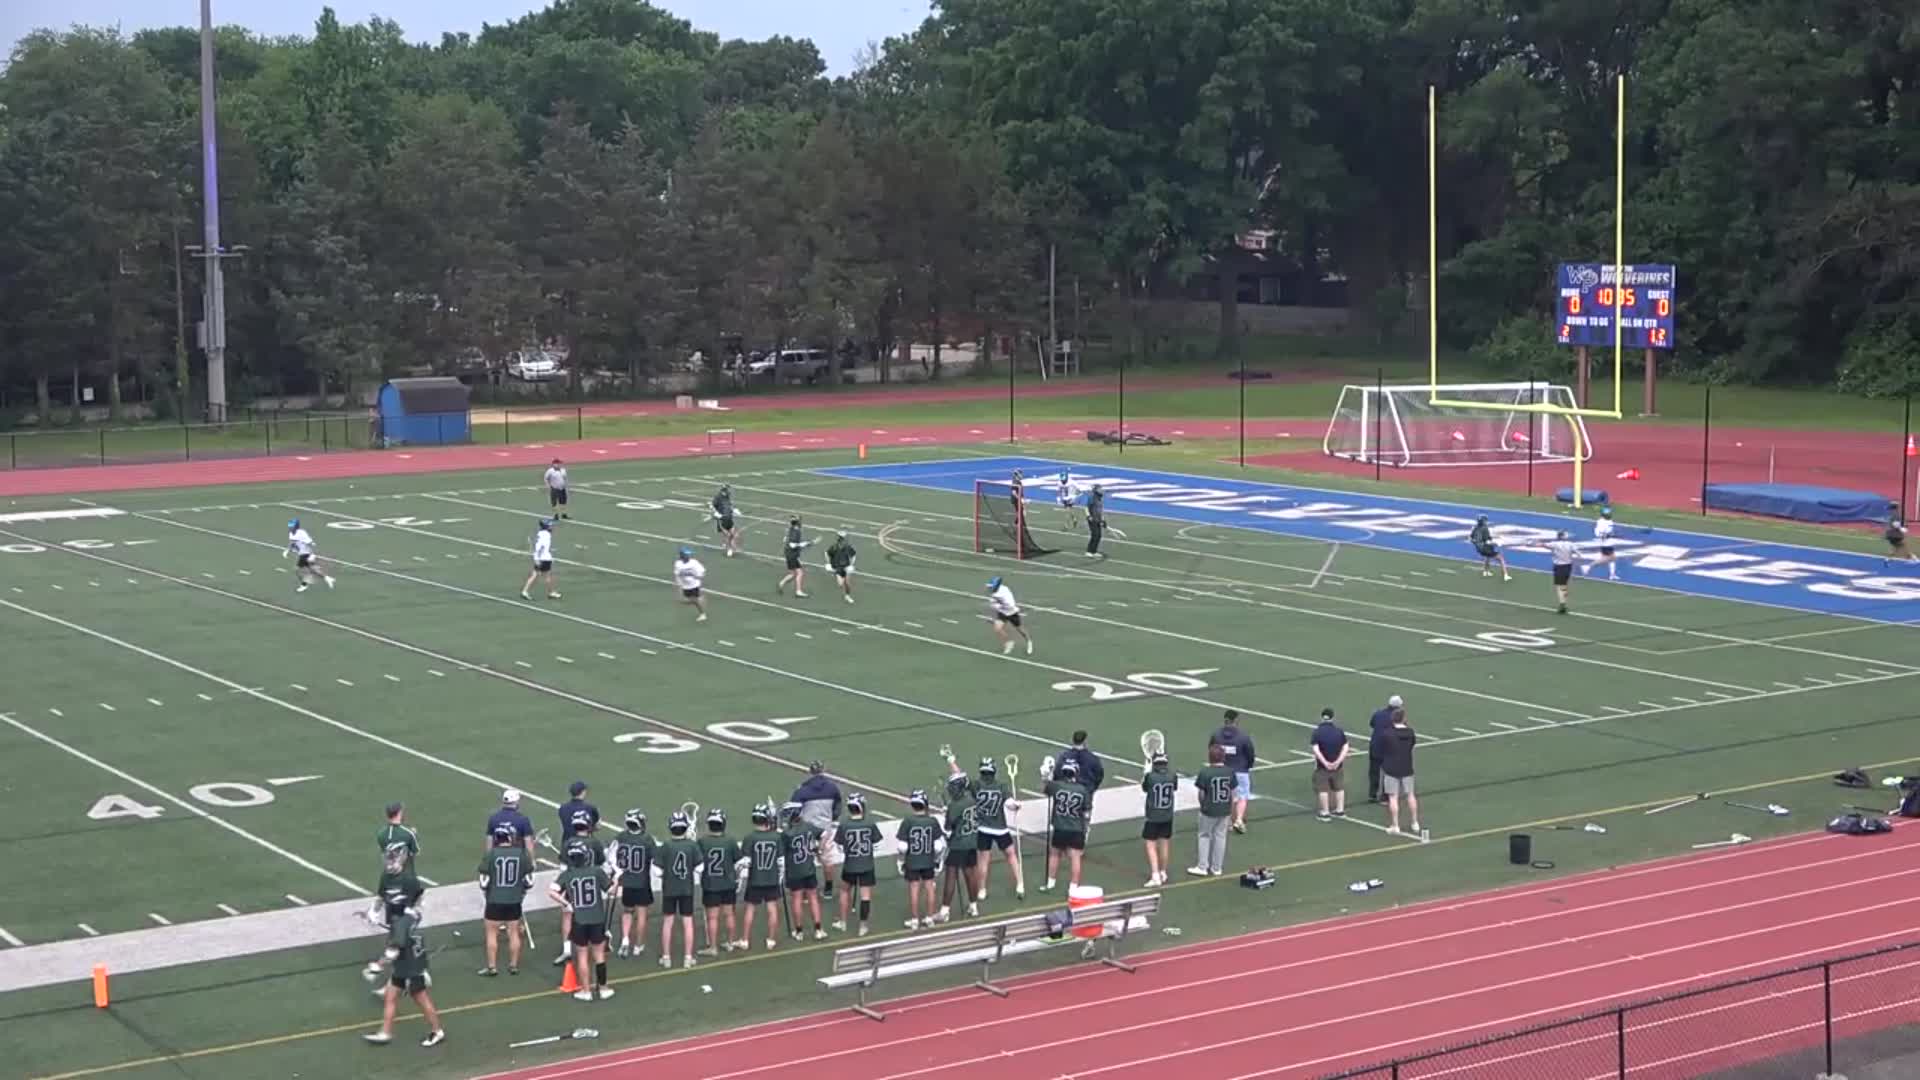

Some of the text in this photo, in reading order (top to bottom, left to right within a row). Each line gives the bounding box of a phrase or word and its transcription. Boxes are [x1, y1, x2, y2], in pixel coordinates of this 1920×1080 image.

[1601, 271, 1670, 286] WOVERINES
[1424, 631, 1557, 652] 10
[1052, 671, 1209, 700] 20
[613, 720, 791, 754] 30
[86, 782, 276, 820] 40
[976, 789, 1002, 818] 27
[1055, 788, 1084, 818] 32
[1153, 782, 1174, 809] 19
[1210, 776, 1231, 804] 15
[844, 827, 873, 858] 25
[909, 826, 933, 855] 31
[672, 851, 688, 880] 4
[707, 847, 725, 876] 2
[754, 840, 777, 871] 17
[494, 856, 520, 888] 10
[569, 875, 598, 909] 16
